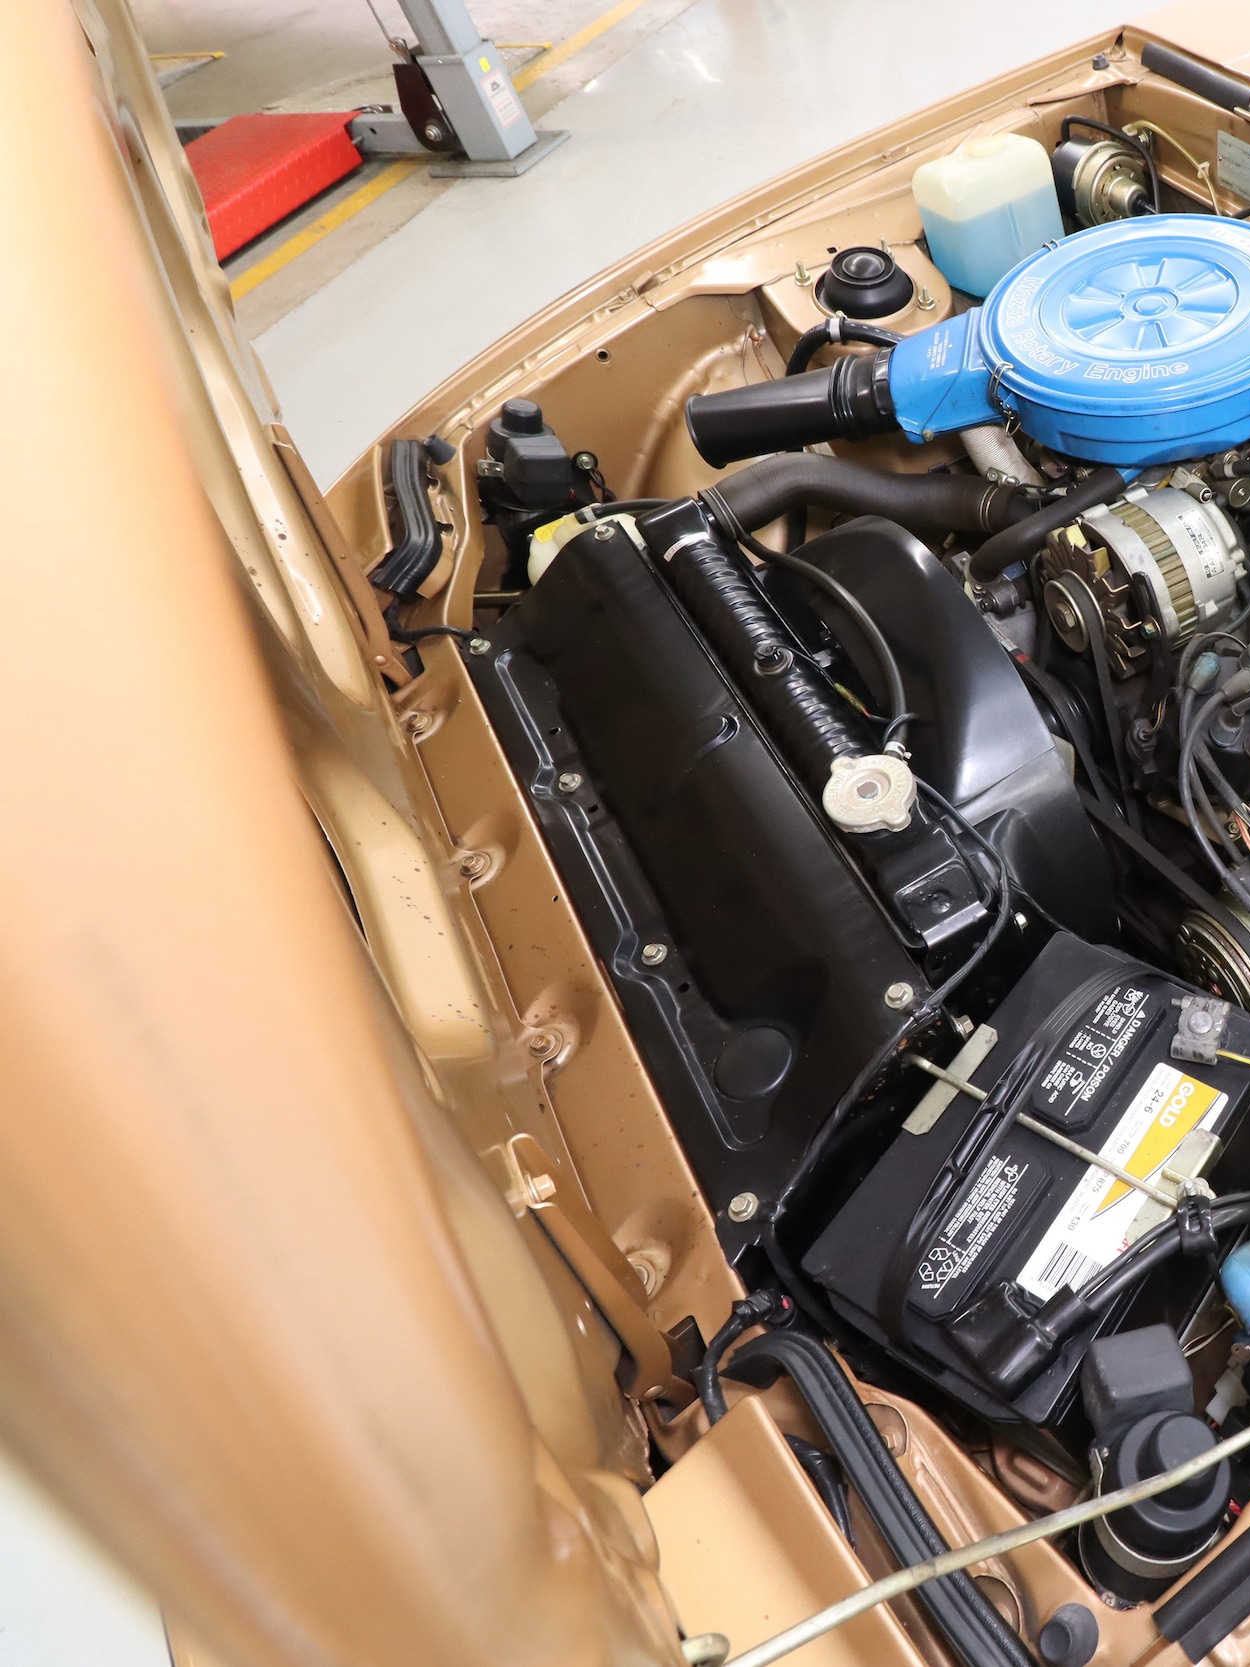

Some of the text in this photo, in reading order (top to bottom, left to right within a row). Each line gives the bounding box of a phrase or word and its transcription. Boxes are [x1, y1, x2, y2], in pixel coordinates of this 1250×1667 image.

[1007, 276, 1189, 384] Mazda Rotary Engine
[1102, 1001, 1123, 1027] EXPLOSIVE
[1108, 1014, 1120, 1027] EYES
[1110, 1016, 1126, 1034] SHIELD
[1085, 1041, 1093, 1050] NO
[1110, 1018, 1141, 1057] DANGER
[1046, 1065, 1075, 1103] SULFURIC ACID
[1080, 1063, 1110, 1101] POISON
[1142, 1088, 1164, 1114] 24-6
[1156, 1078, 1196, 1129] GOLD
[1115, 1138, 1130, 1155] 700
[983, 1176, 1001, 1199] MEDICAL
[993, 1179, 1005, 1193] WITH
[1090, 1176, 1106, 1194] 875
[965, 1182, 1010, 1243] FLUSH EYES IMMEDIATELY
[974, 1197, 986, 1211] HELP
[966, 1210, 977, 1224] FAST
[974, 1210, 984, 1221] GET
[1066, 1213, 1081, 1231] 130
